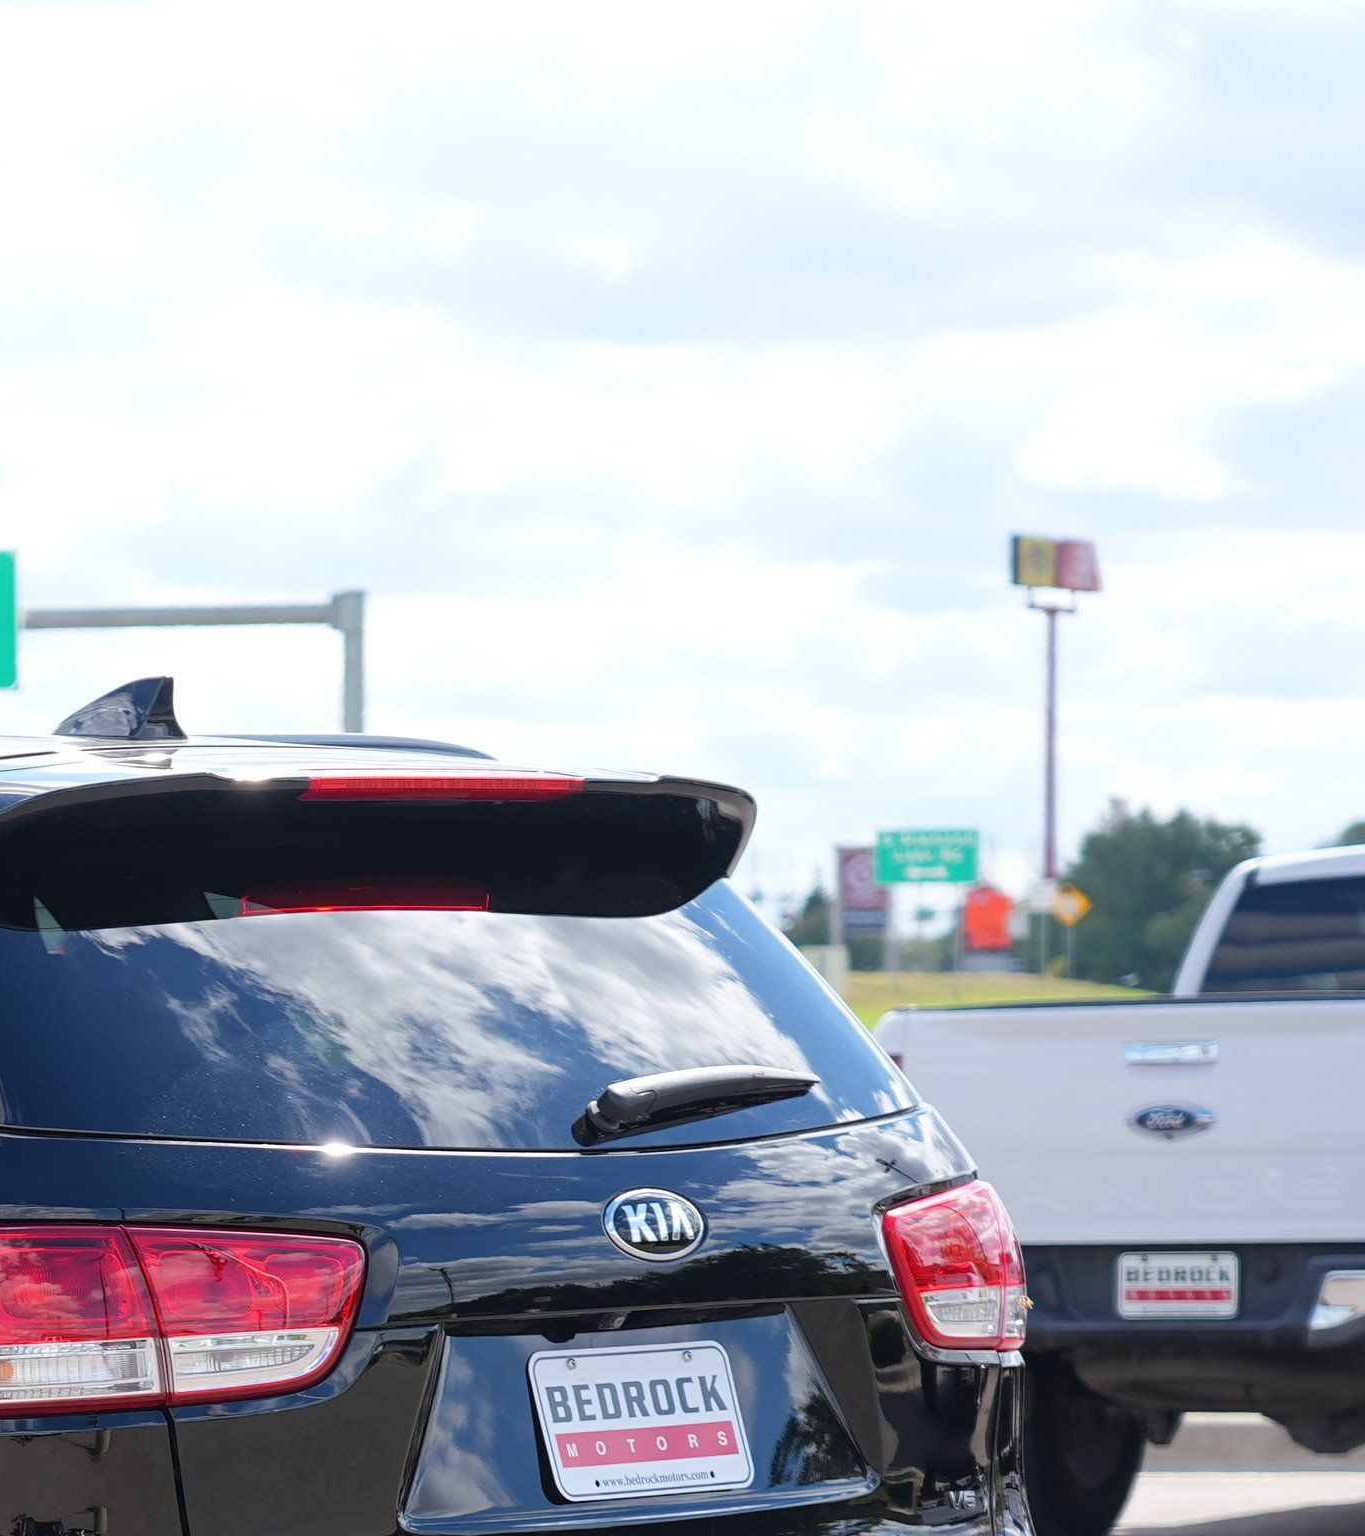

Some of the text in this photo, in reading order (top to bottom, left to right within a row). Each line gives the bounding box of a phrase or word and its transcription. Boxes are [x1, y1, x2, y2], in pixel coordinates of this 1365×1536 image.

[621, 1202, 695, 1243] KIA
[1125, 1265, 1231, 1282] BEDROCK
[545, 1374, 728, 1423] BEDROCK
[565, 1430, 728, 1458] MOTORS
[602, 1470, 709, 1488] www.bedrockmotors.com
